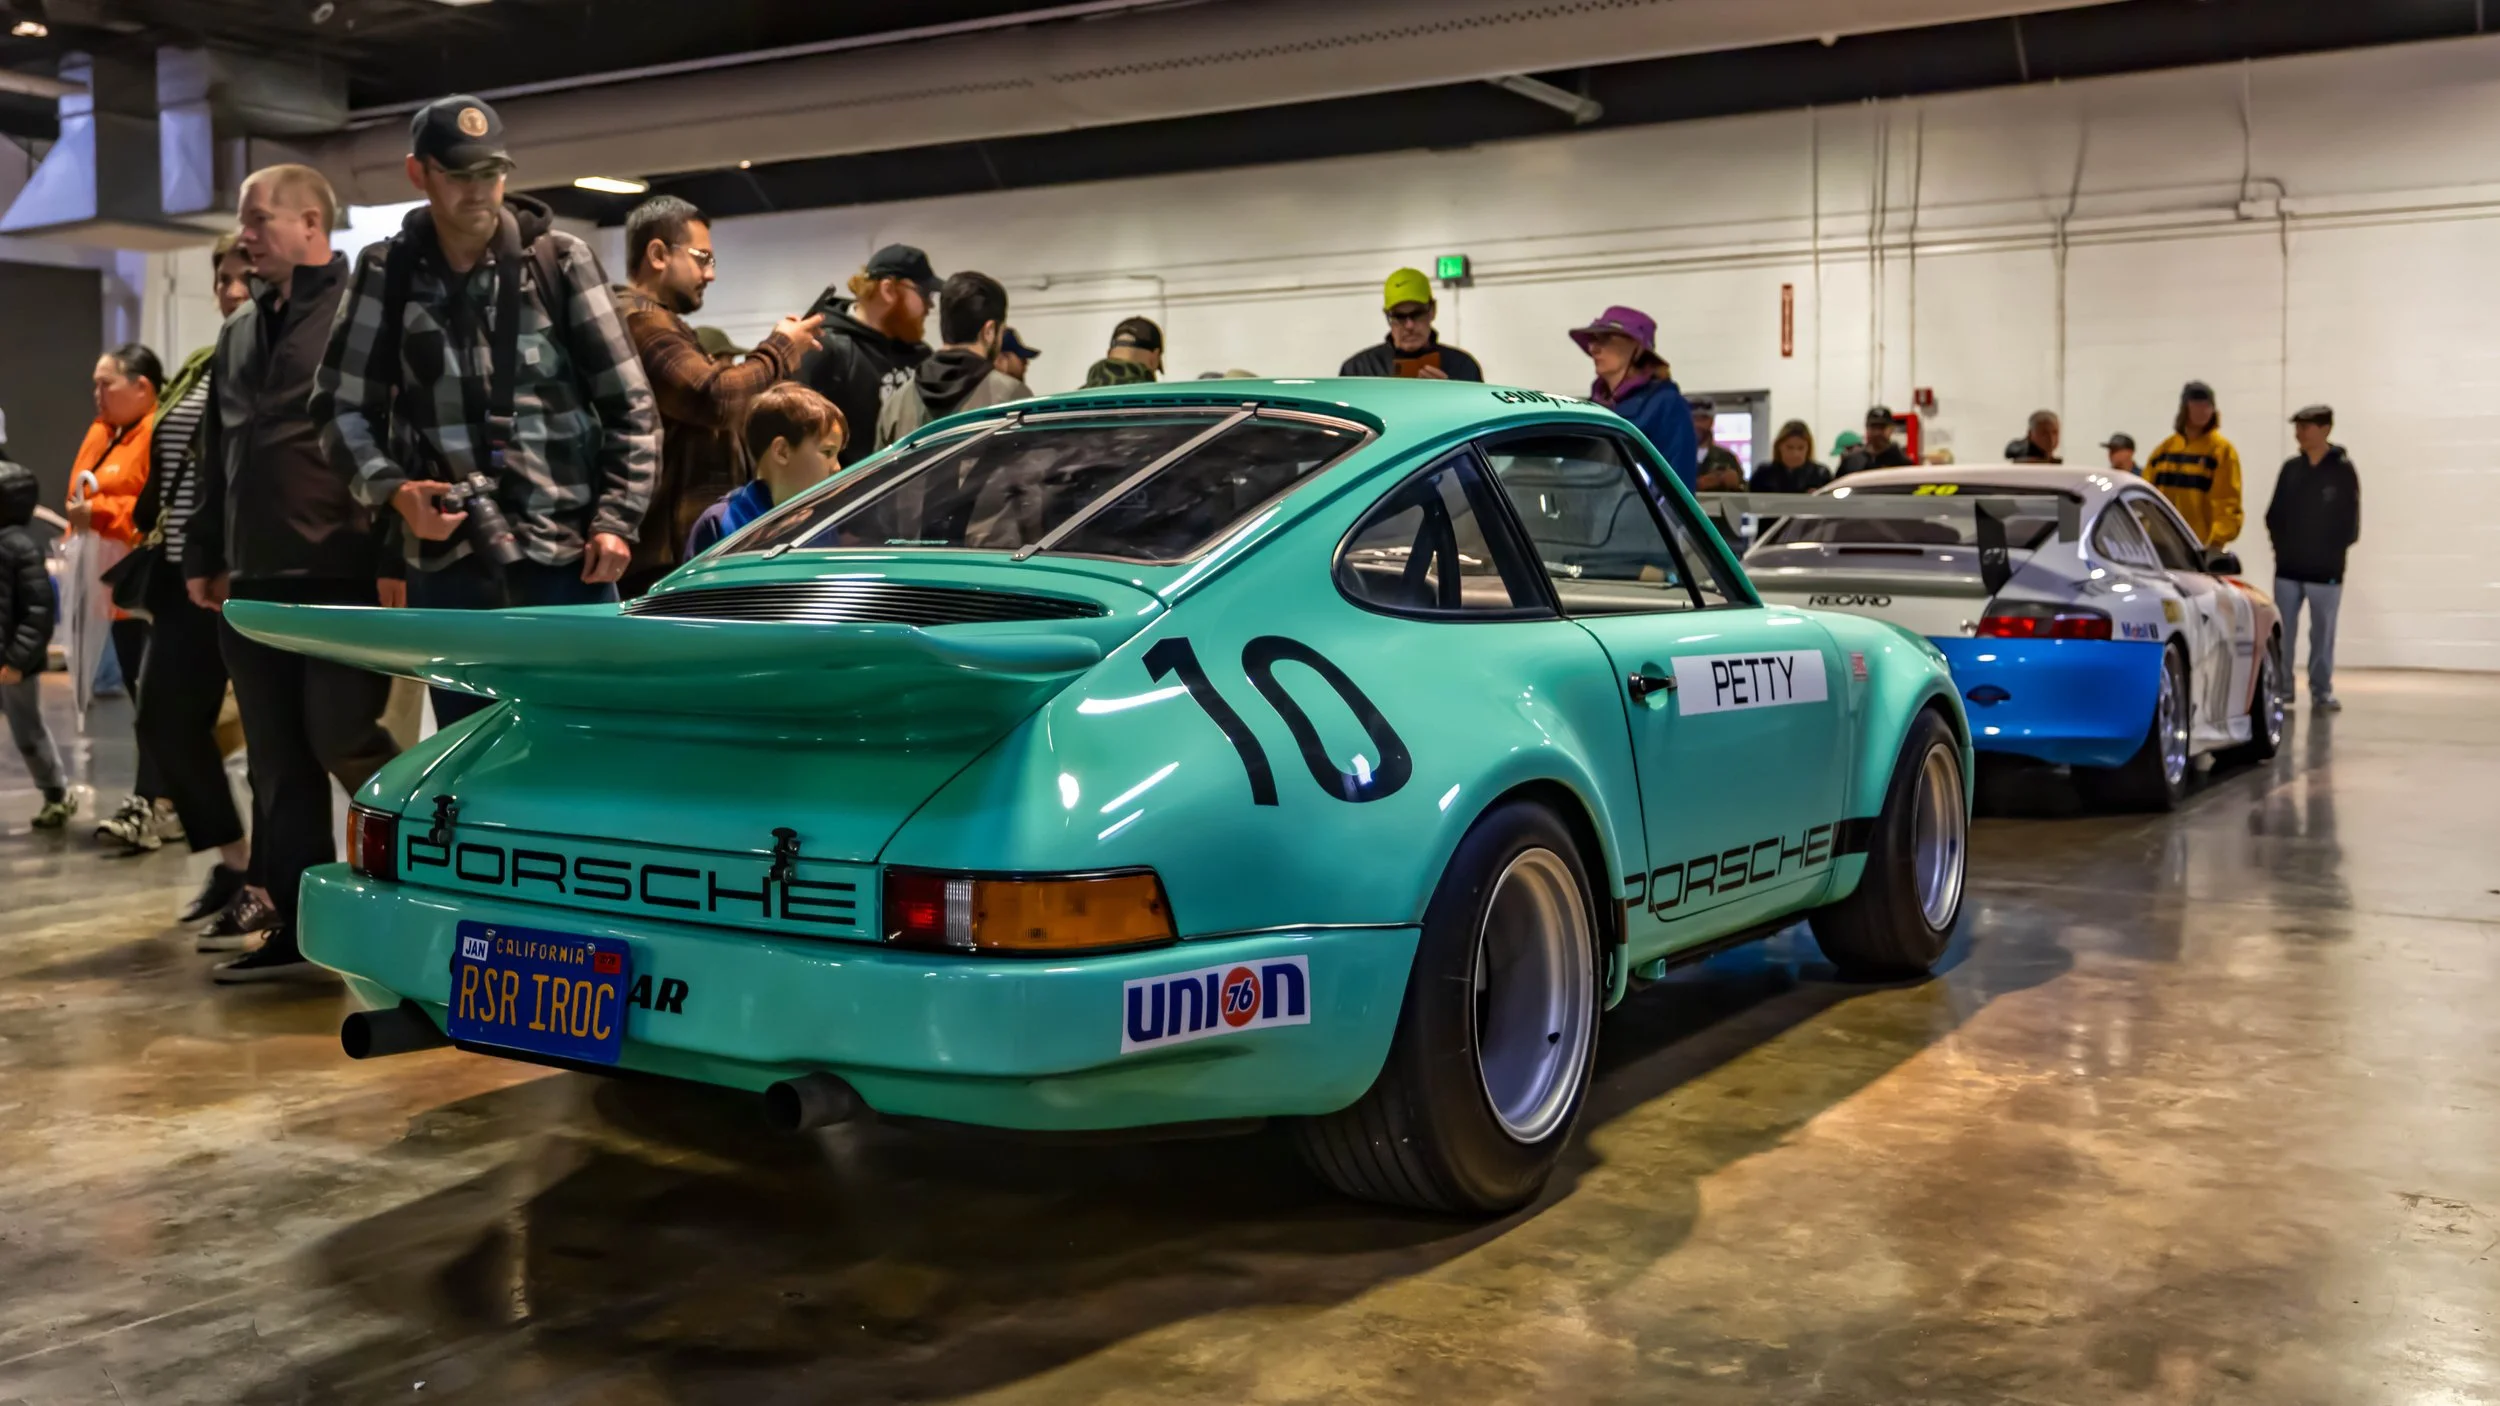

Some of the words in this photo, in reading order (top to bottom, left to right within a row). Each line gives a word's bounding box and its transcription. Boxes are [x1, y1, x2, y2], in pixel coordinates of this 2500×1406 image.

[1711, 656, 1794, 706] PETTY
[1141, 635, 1413, 806] 10
[406, 834, 857, 926] PORSCHE
[1623, 822, 1832, 914] PORSCHE
[465, 939, 488, 959] JAN
[496, 937, 585, 966] CALIFORNIA
[458, 964, 520, 1027] RSR
[528, 973, 615, 1041] IROC
[1226, 977, 1255, 1015] 76
